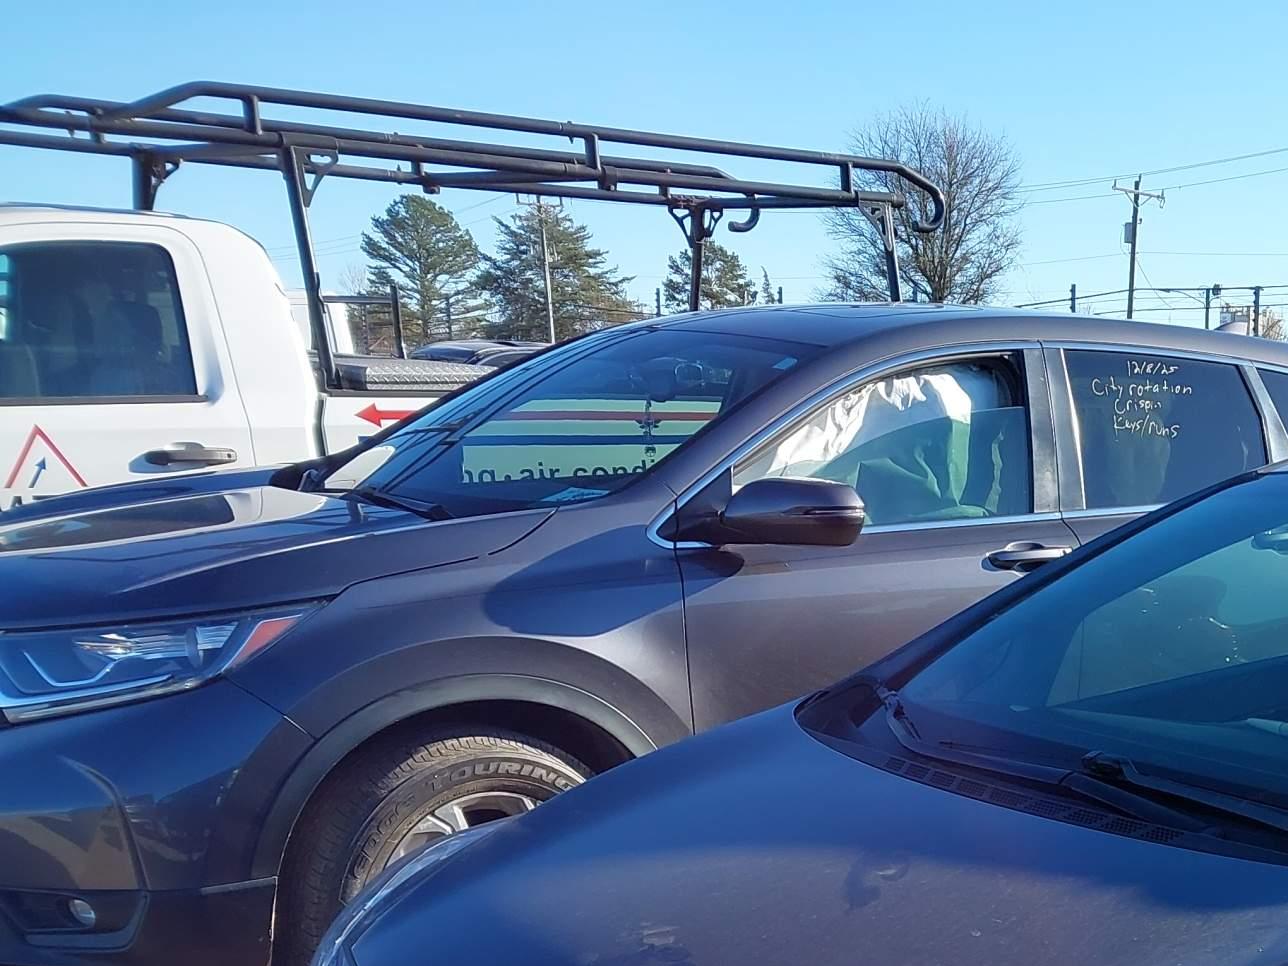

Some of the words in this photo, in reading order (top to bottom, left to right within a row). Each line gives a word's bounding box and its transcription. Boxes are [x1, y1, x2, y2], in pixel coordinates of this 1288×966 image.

[1127, 360, 1179, 377] 12/8/25
[1091, 376, 1123, 399] City
[1128, 379, 1193, 397] rotation
